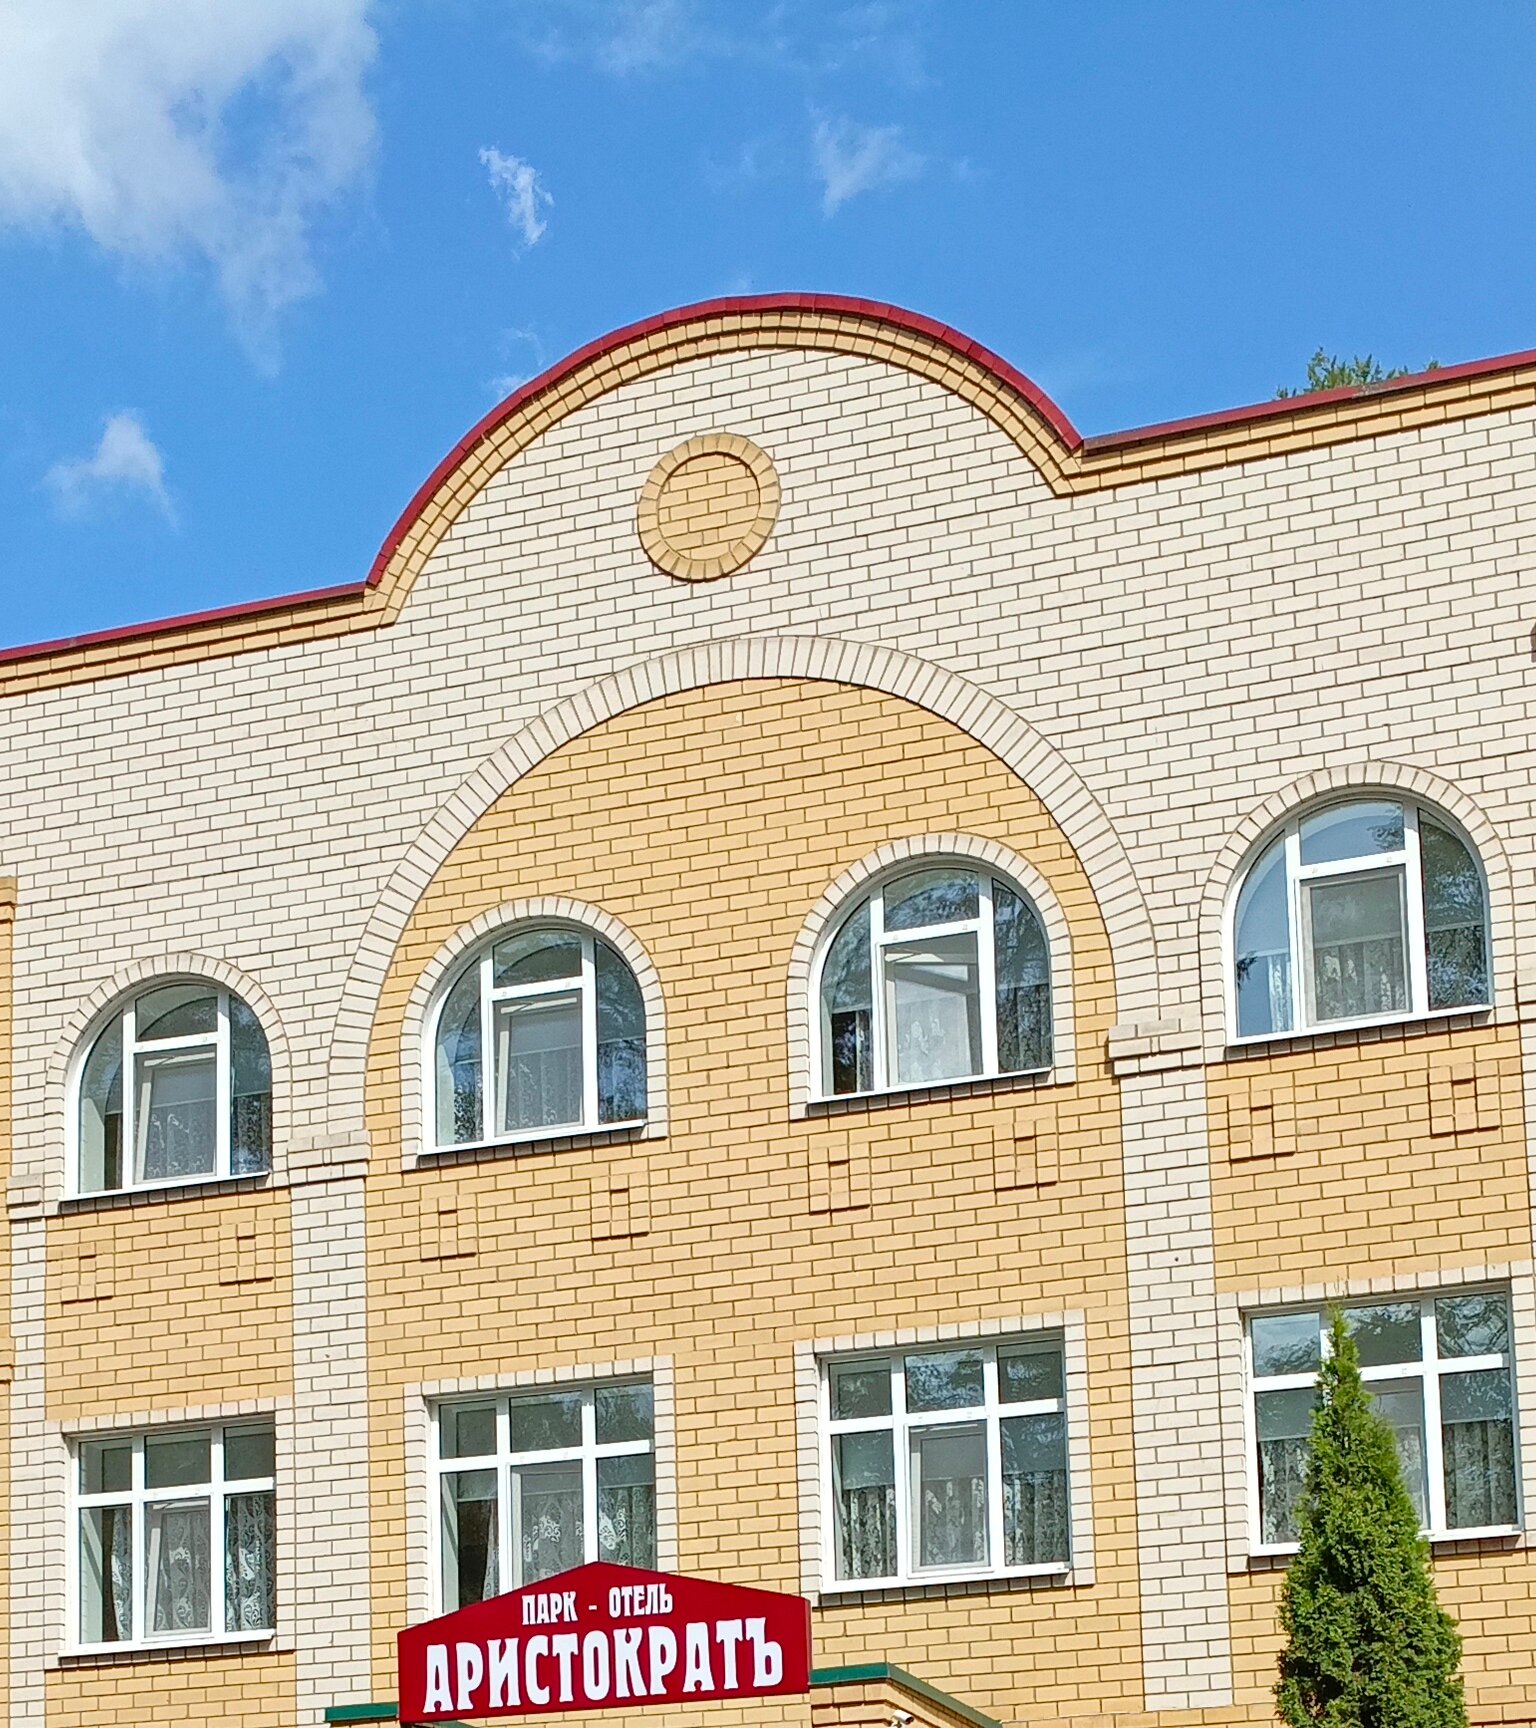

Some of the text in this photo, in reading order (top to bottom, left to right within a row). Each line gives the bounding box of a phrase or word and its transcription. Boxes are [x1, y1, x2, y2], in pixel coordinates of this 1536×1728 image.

[522, 1592, 578, 1625] ПАРК
[608, 1583, 673, 1617] ОТЕЛЬ
[422, 1616, 783, 1713] АРИСТОКРАТЪ
